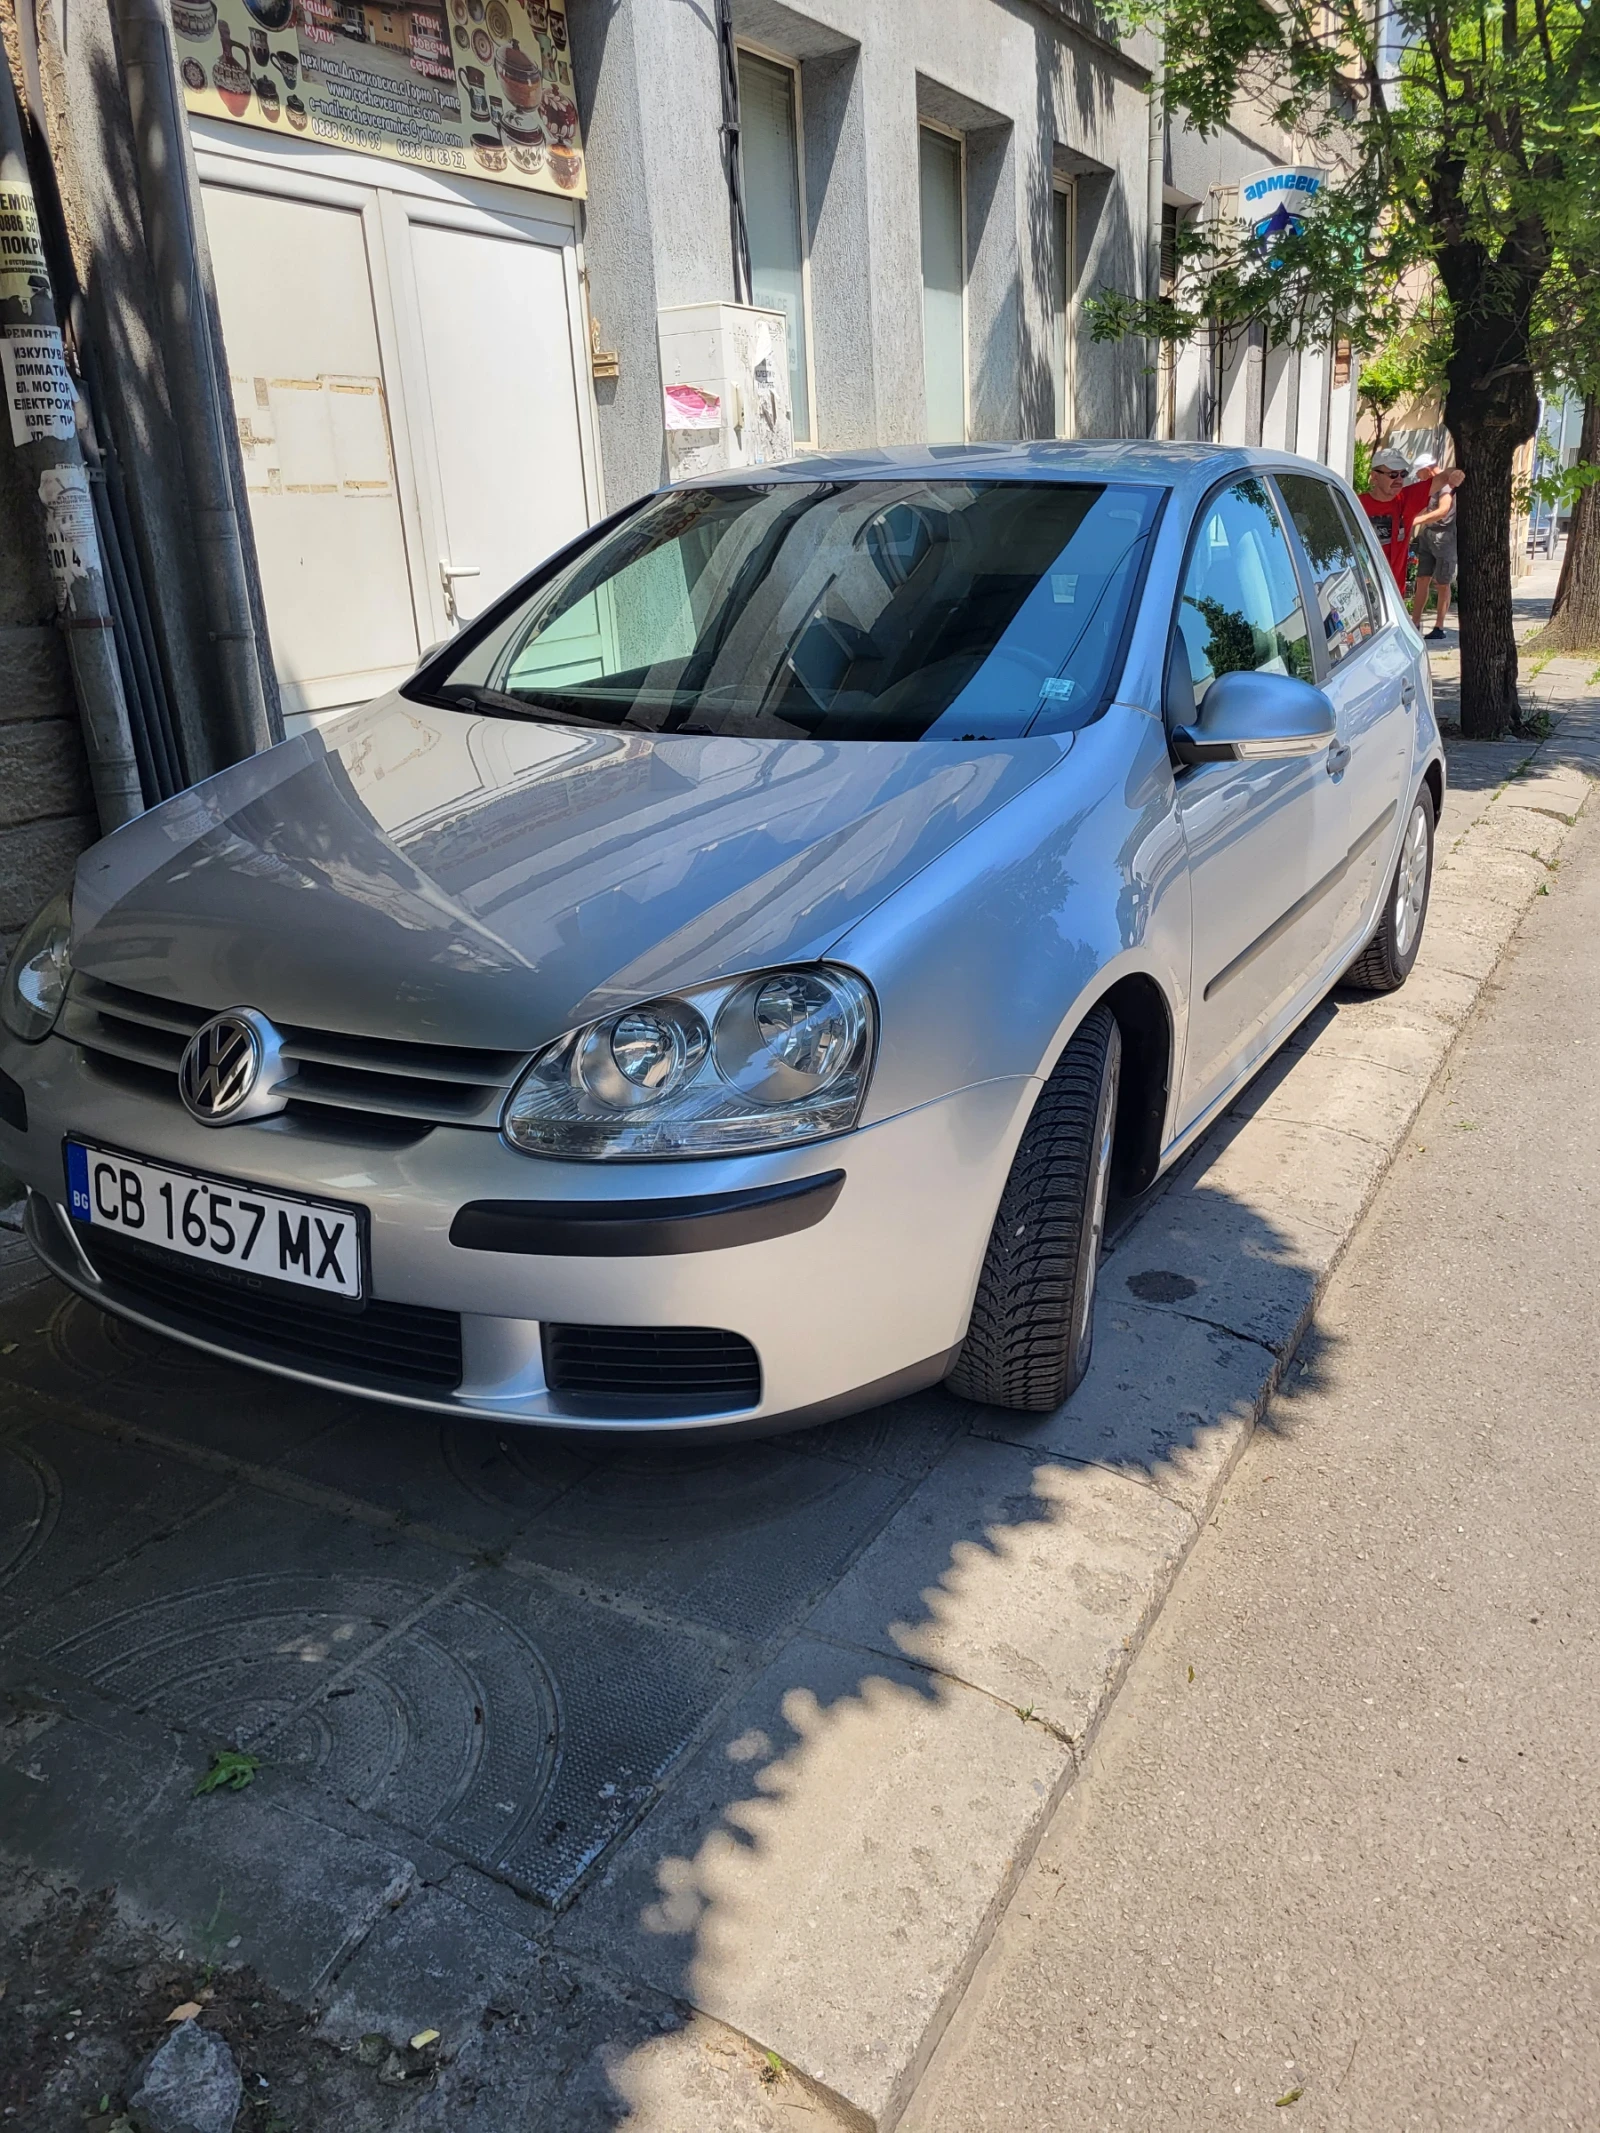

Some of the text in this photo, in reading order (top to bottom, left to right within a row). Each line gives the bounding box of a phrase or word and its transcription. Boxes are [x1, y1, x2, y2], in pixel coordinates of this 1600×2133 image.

[412, 12, 440, 31] тави
[304, 23, 335, 45] купи
[300, 53, 318, 69] цех
[409, 58, 456, 81] сервизи
[326, 80, 441, 124] www.cochevceramics.com
[312, 118, 382, 151] 0888 96 10 99
[397, 139, 466, 169] 0888 81 83 22
[1243, 173, 1320, 202] армеец
[0, 193, 35, 213] ЕМОН
[14, 398, 72, 411] ЕЛЕКТРОЖ
[72, 1190, 90, 1210] BG
[93, 1162, 347, 1284] CB 1657 MX
[133, 1243, 262, 1288] REMAX AUTO
